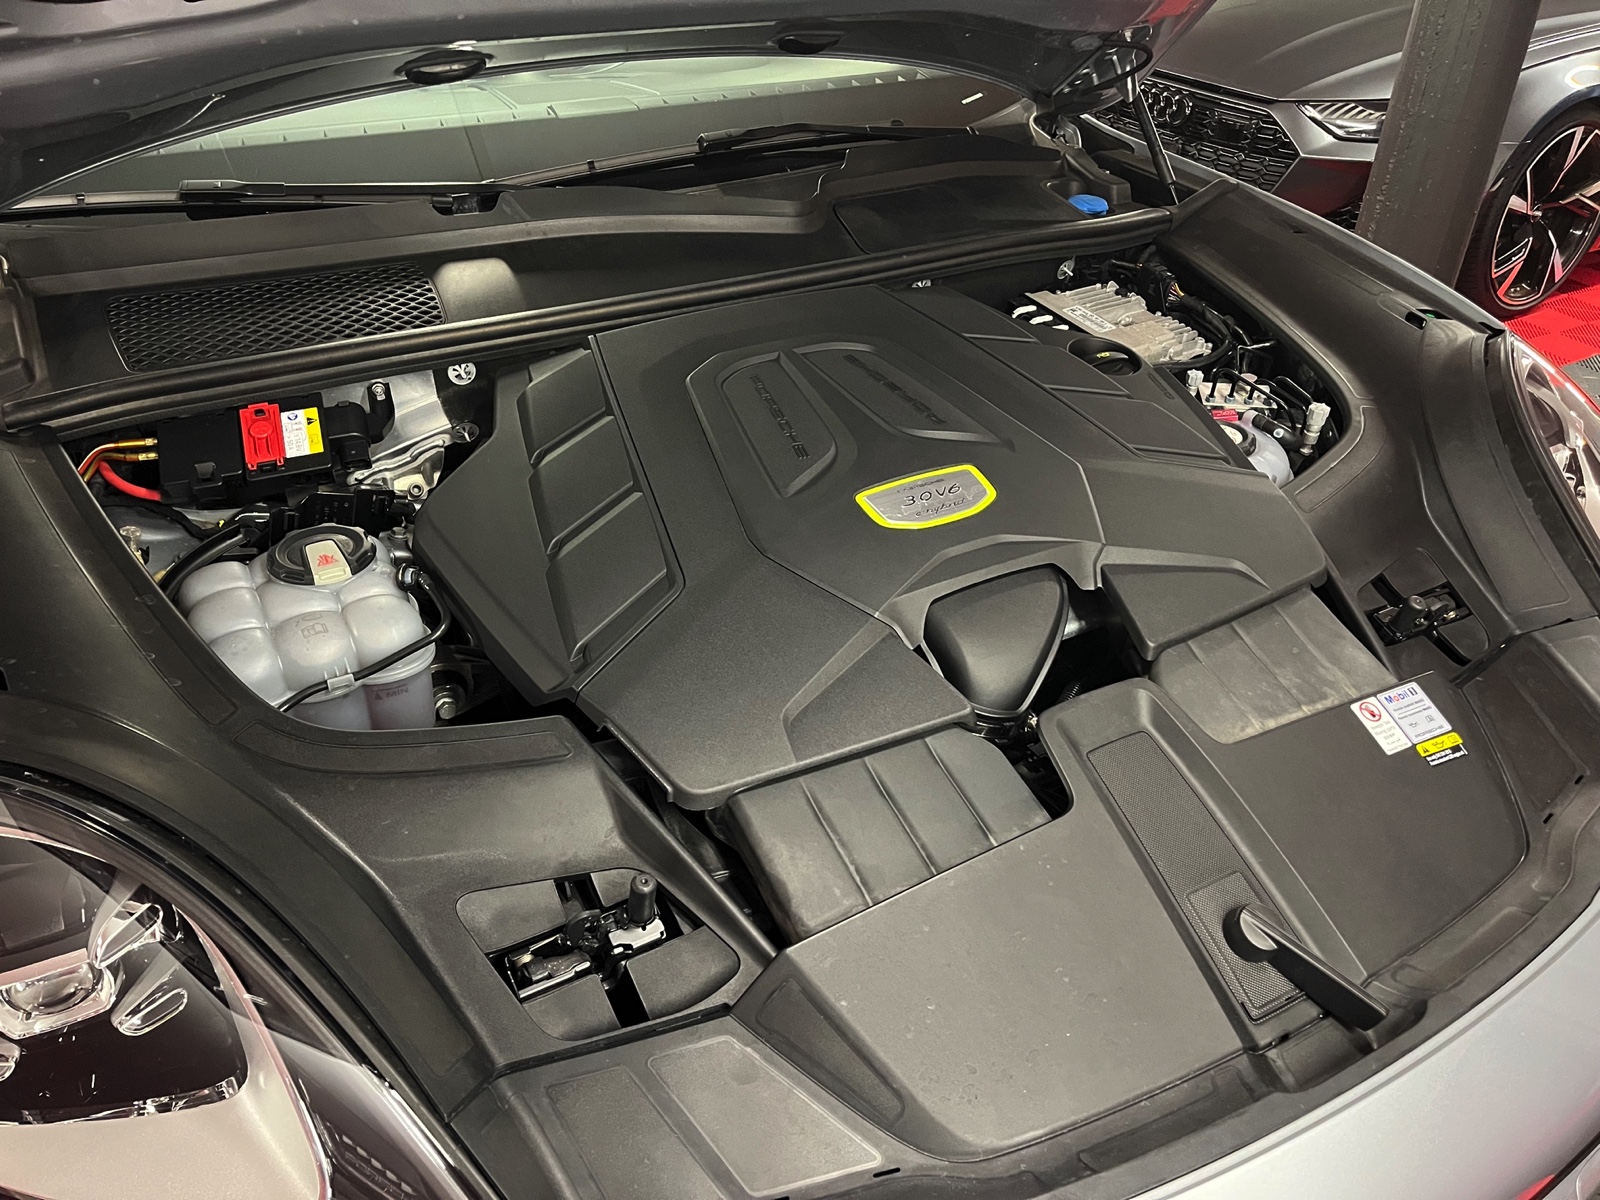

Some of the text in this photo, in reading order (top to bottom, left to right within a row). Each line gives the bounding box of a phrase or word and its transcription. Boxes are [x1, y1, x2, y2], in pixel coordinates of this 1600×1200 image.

[748, 374, 811, 460] PORSCHE
[935, 483, 961, 498] V6
[386, 687, 409, 698] MIN
[1384, 689, 1410, 704] Mobil
